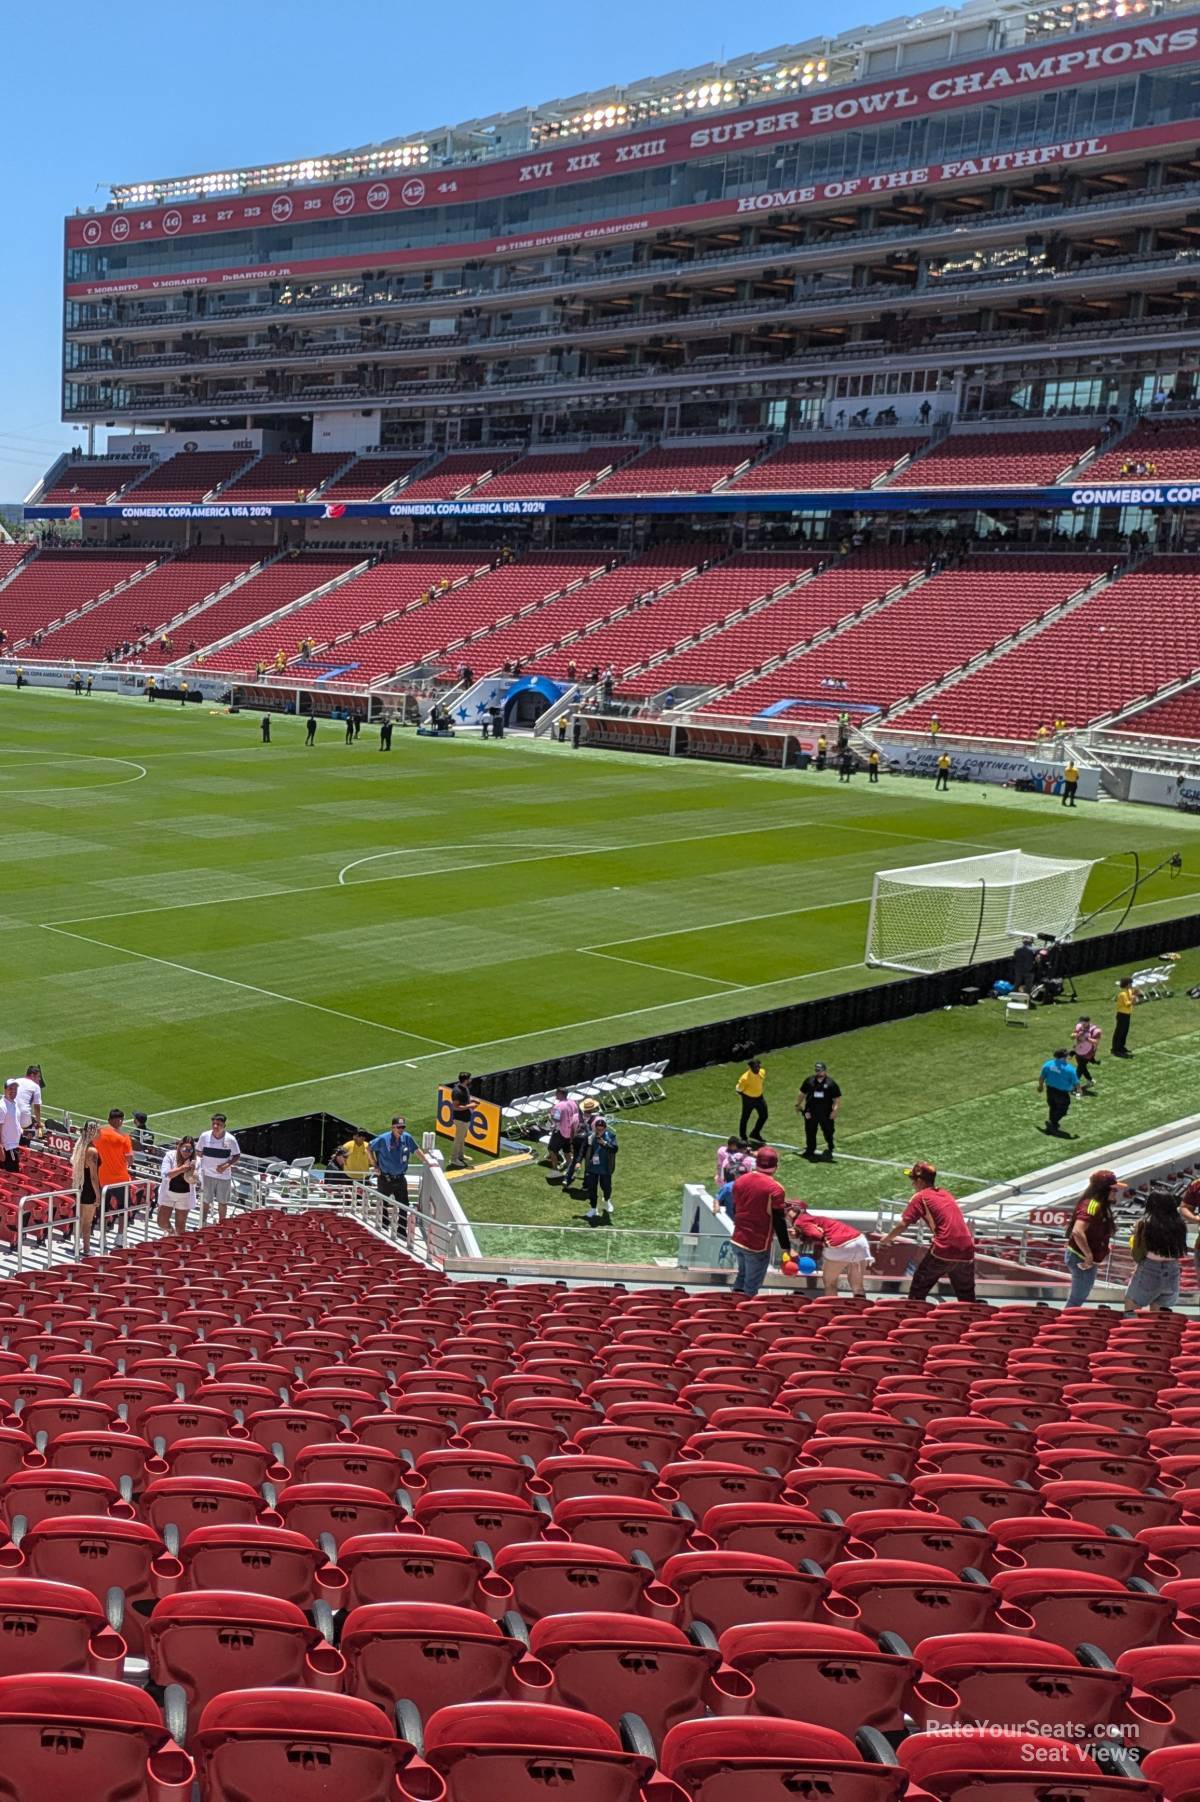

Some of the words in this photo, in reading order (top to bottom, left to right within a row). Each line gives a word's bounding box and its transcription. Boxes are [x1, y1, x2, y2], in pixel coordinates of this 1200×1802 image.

[690, 111, 799, 150] SUPER
[809, 88, 918, 126] BOWL
[927, 27, 1199, 102] CHAMPIONS
[518, 161, 553, 182] XVI
[566, 152, 600, 172] XIX
[616, 138, 666, 163] XXIII
[736, 186, 816, 214] HOME
[824, 179, 864, 198] OF
[869, 166, 929, 190] THE
[940, 138, 1108, 180] FAITHFUL
[88, 228, 96, 236] 8
[114, 222, 128, 233] 12
[139, 220, 152, 230] 14
[165, 217, 180, 227] 16
[192, 214, 207, 224] 21
[216, 210, 234, 221] 27
[274, 204, 290, 214] 34
[304, 199, 321, 210] 35
[334, 195, 352, 206] 37
[403, 186, 424, 197] 42
[437, 182, 458, 192] 44
[535, 230, 582, 247] DIVISION
[584, 220, 648, 238] CHAMPIONS
[1072, 488, 1164, 504] CONMEBOL
[122, 508, 168, 518] CONMEBOL
[168, 508, 190, 518] COPA
[190, 507, 230, 517] AMERICA
[232, 506, 248, 517] USA
[250, 506, 272, 517] 2024
[390, 504, 436, 516] CONMEBOL
[436, 504, 461, 514] COPA
[461, 503, 501, 514] AMERICA
[502, 502, 520, 514] USA
[522, 502, 546, 513] 2024
[49, 1136, 70, 1152] 108
[1032, 1211, 1065, 1225] 106
